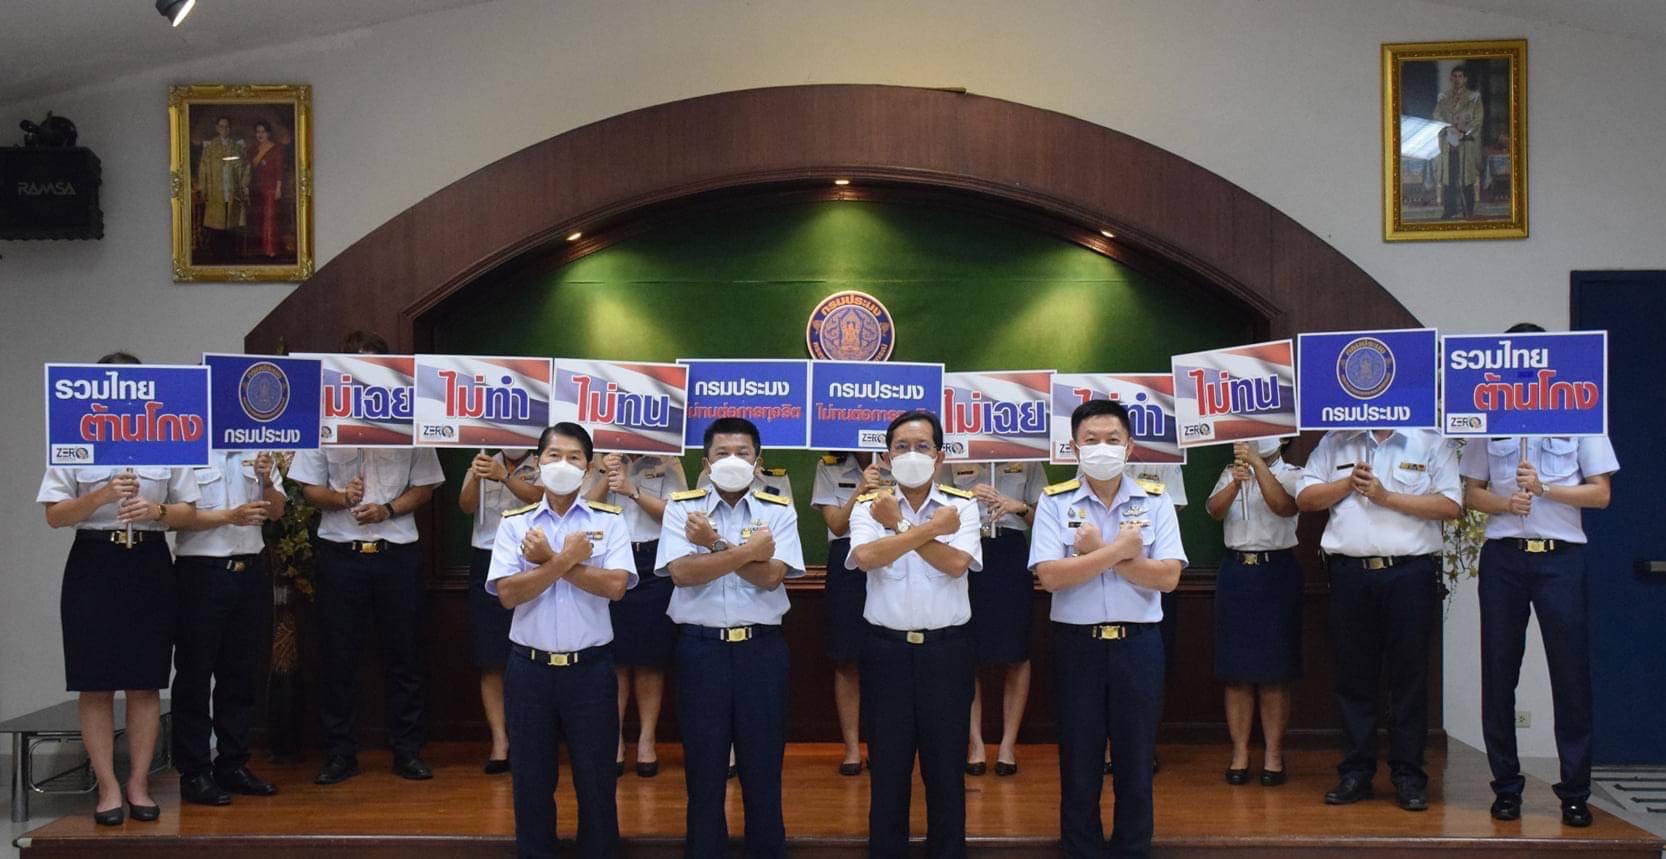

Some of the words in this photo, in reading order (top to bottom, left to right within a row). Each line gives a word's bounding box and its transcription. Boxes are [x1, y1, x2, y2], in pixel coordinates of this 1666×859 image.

[17, 181, 76, 196] RAMSA
[820, 294, 882, 317] กรมประมง
[1450, 340, 1549, 370] รวมไทย
[55, 370, 156, 400] รวมไทย
[324, 374, 414, 420] ม่เฉย
[438, 369, 530, 420] ไม่ทำ
[694, 378, 790, 397] กรมประมง
[829, 380, 925, 400] กรมประมง
[1188, 367, 1281, 417] ไม่ทน
[1473, 369, 1599, 411] ต้านโกง
[571, 374, 671, 428] ไม่ทน
[943, 386, 1047, 434] ไม่เฉย
[1321, 403, 1411, 422] กรมประมง
[80, 401, 204, 442] ต้านโกง
[224, 426, 301, 444] กรมประมง
